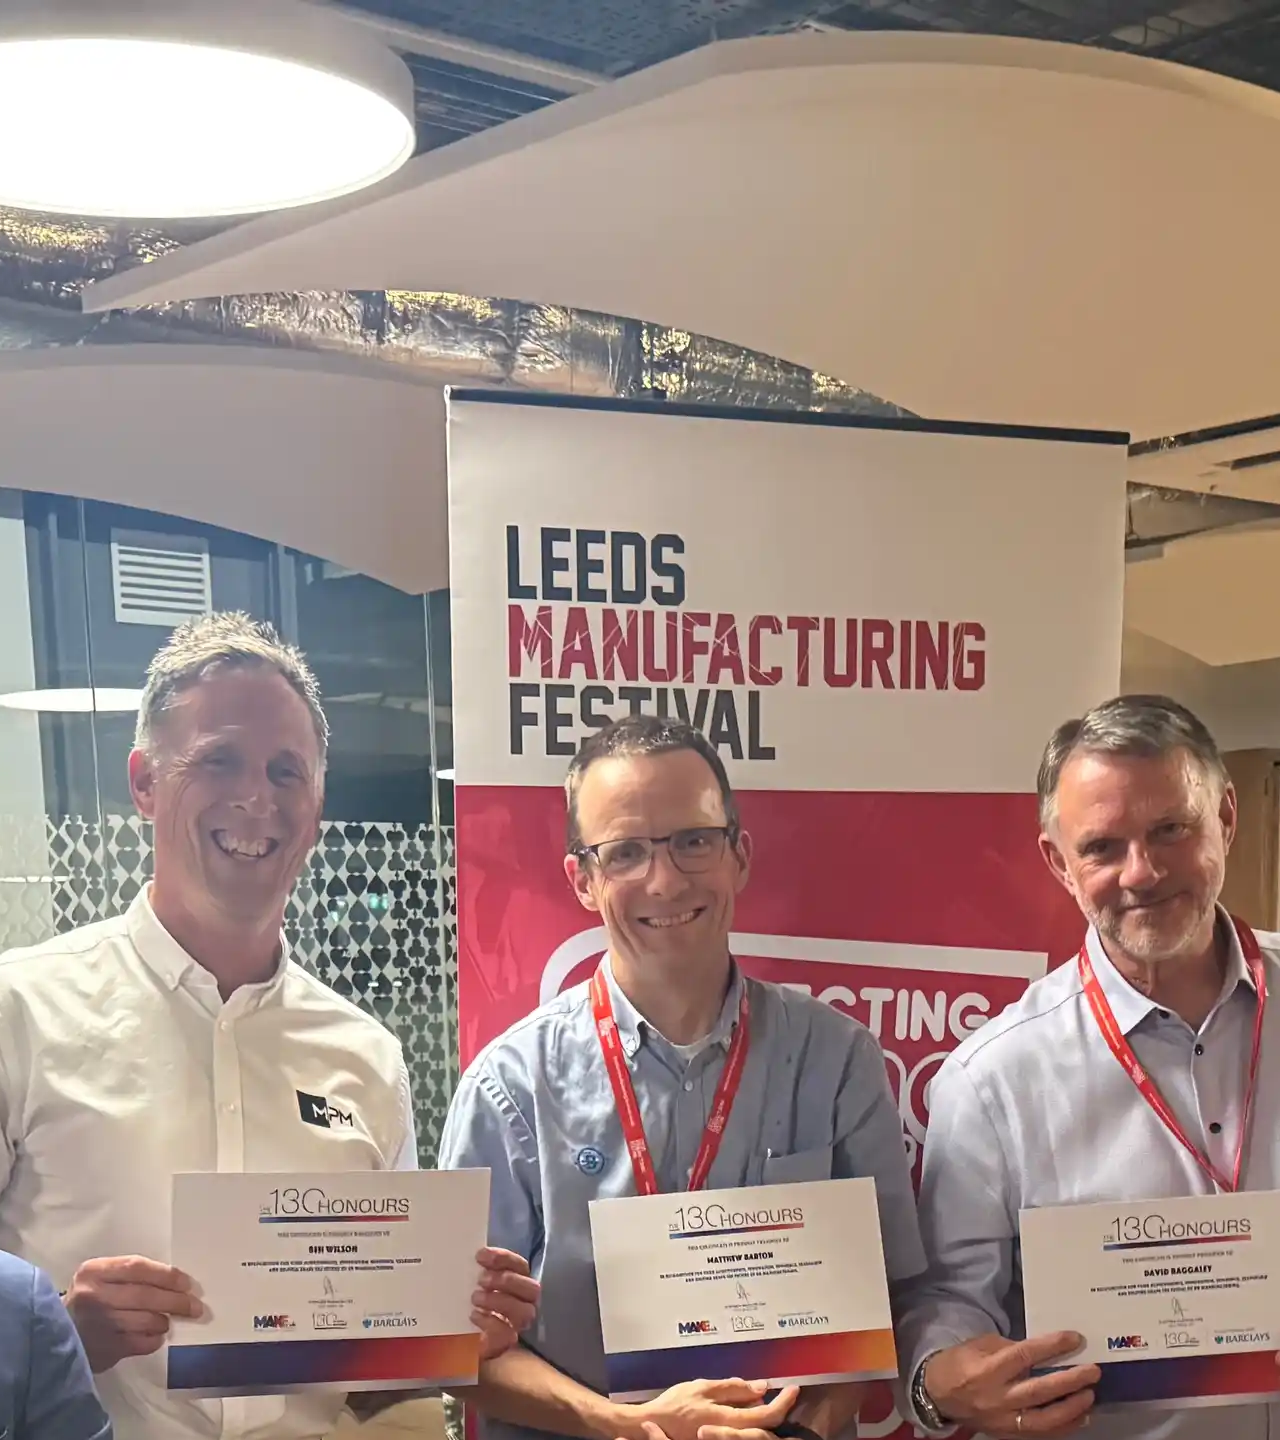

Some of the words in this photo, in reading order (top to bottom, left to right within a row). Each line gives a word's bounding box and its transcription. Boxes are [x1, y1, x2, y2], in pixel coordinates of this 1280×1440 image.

[506, 525, 685, 606] LEEDS
[507, 604, 986, 691] MANUFACTURING
[779, 983, 991, 1043] TING
[311, 1103, 354, 1127] MPM
[318, 1198, 410, 1214] HONOURS
[720, 1207, 804, 1228] HONOURS
[1159, 1218, 1252, 1239] HONOURS
[1144, 1267, 1169, 1277] DAVID
[1225, 1332, 1271, 1344] BARCLAYS
